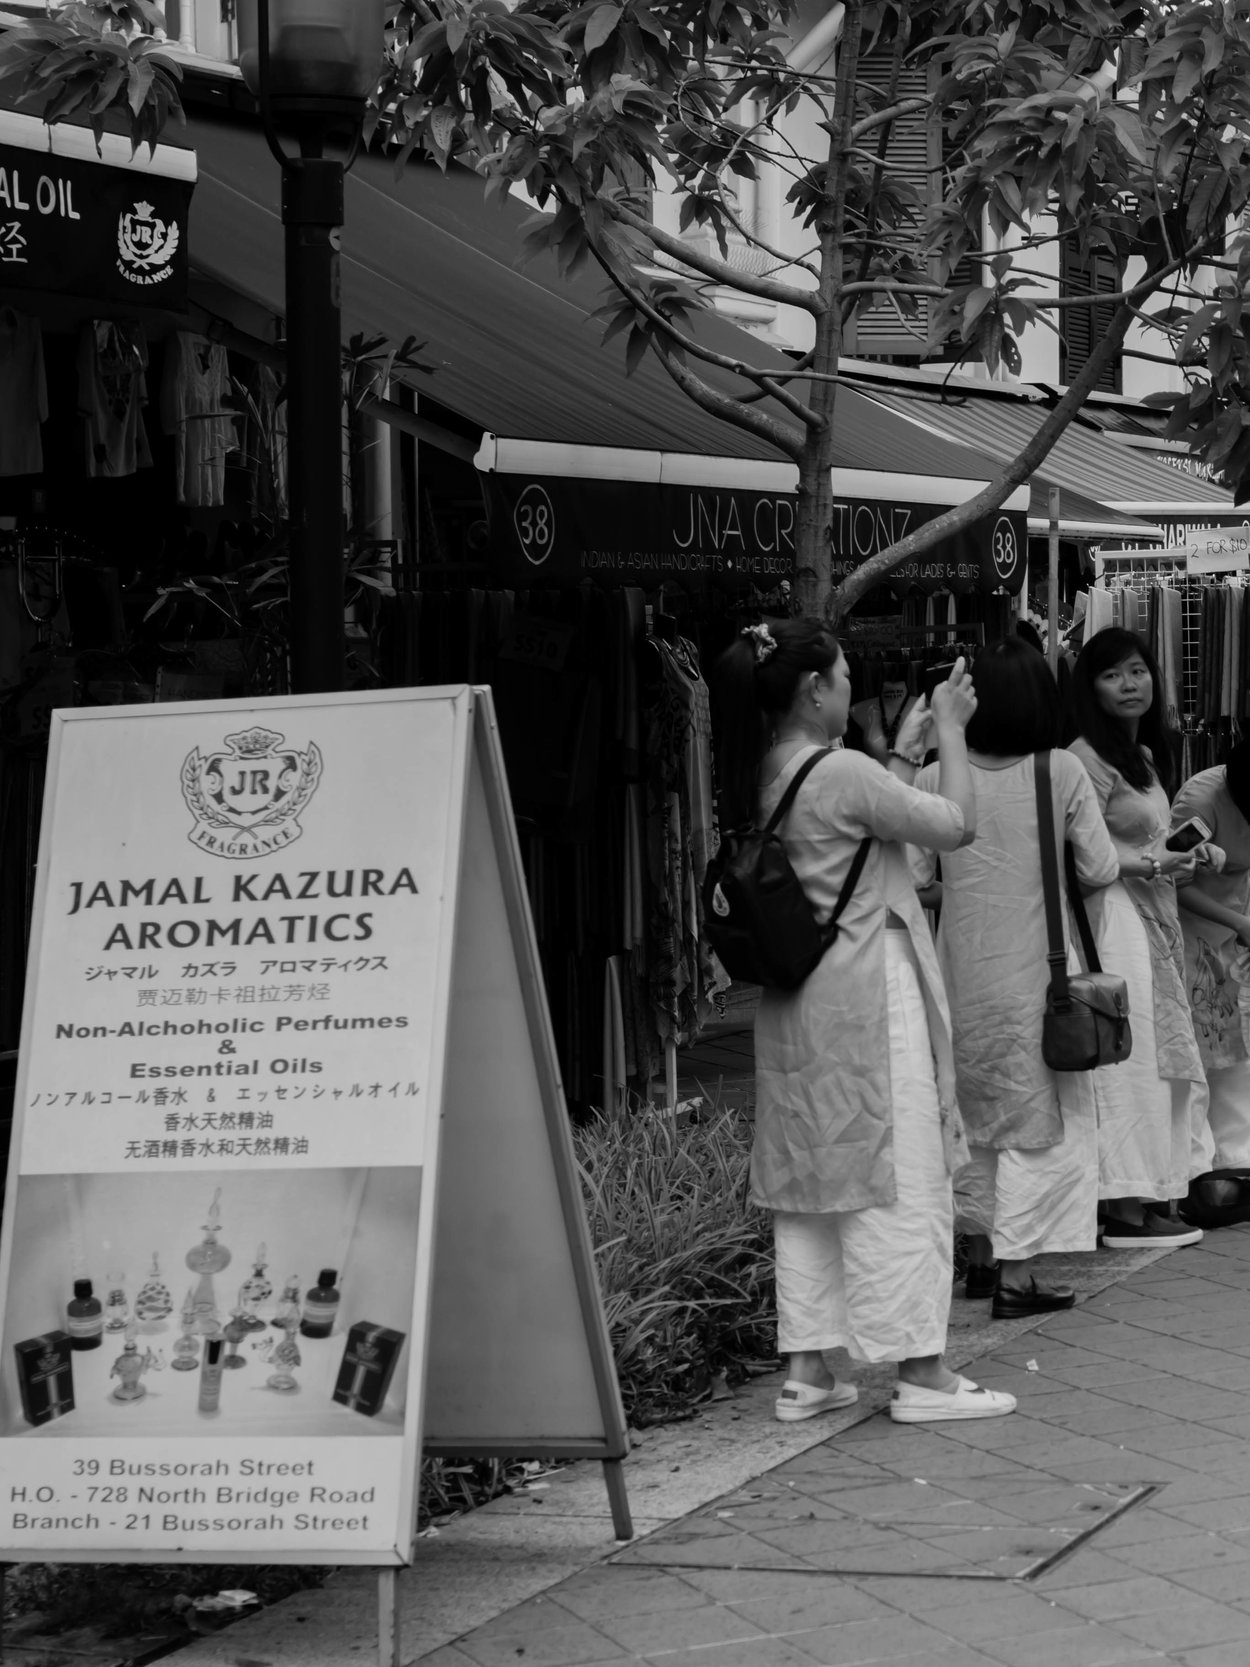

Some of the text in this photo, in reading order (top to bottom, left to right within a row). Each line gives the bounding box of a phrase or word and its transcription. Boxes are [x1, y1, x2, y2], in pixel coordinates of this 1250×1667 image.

[36, 175, 81, 220] OIL
[131, 224, 153, 245] JR
[116, 258, 174, 285] FRAGRANCE
[520, 504, 549, 545] 38
[673, 492, 912, 558] JNA CRTIONZ
[995, 531, 1014, 564] 38
[1191, 538, 1248, 558] 2 FOR $10
[580, 550, 615, 568] INDIAN
[627, 552, 659, 570] ASIAN
[736, 556, 761, 574] HOME
[229, 769, 271, 796] JR
[197, 826, 294, 856] FRAGRANCE
[66, 867, 420, 916] JAMAL KAZURA
[103, 912, 374, 951] AROMATICS
[84, 955, 390, 982] ジャマル カズラ アロマティクス
[135, 981, 332, 1008] 贾迈勒卡祖拉芳烃
[55, 1013, 410, 1040] Non-Alchoholic Perfumes
[217, 1038, 238, 1056] &
[129, 1058, 324, 1079] Essential Oils
[30, 1081, 421, 1107] ノンアルコール香水 & エッセンシャルオイル
[164, 1111, 274, 1132] 香水天然精油
[123, 1135, 310, 1160] 无酒精香水和天然精油
[72, 1458, 315, 1476] 39 Bussorah Street
[10, 1486, 62, 1503] H.O.
[86, 1486, 129, 1503] 728
[138, 1486, 206, 1504] North
[215, 1486, 300, 1508] Bridge
[309, 1486, 375, 1504] Road
[12, 1513, 100, 1530] Branch
[124, 1513, 152, 1531] 21
[161, 1513, 285, 1532] Bussorah
[294, 1513, 370, 1531] Street
